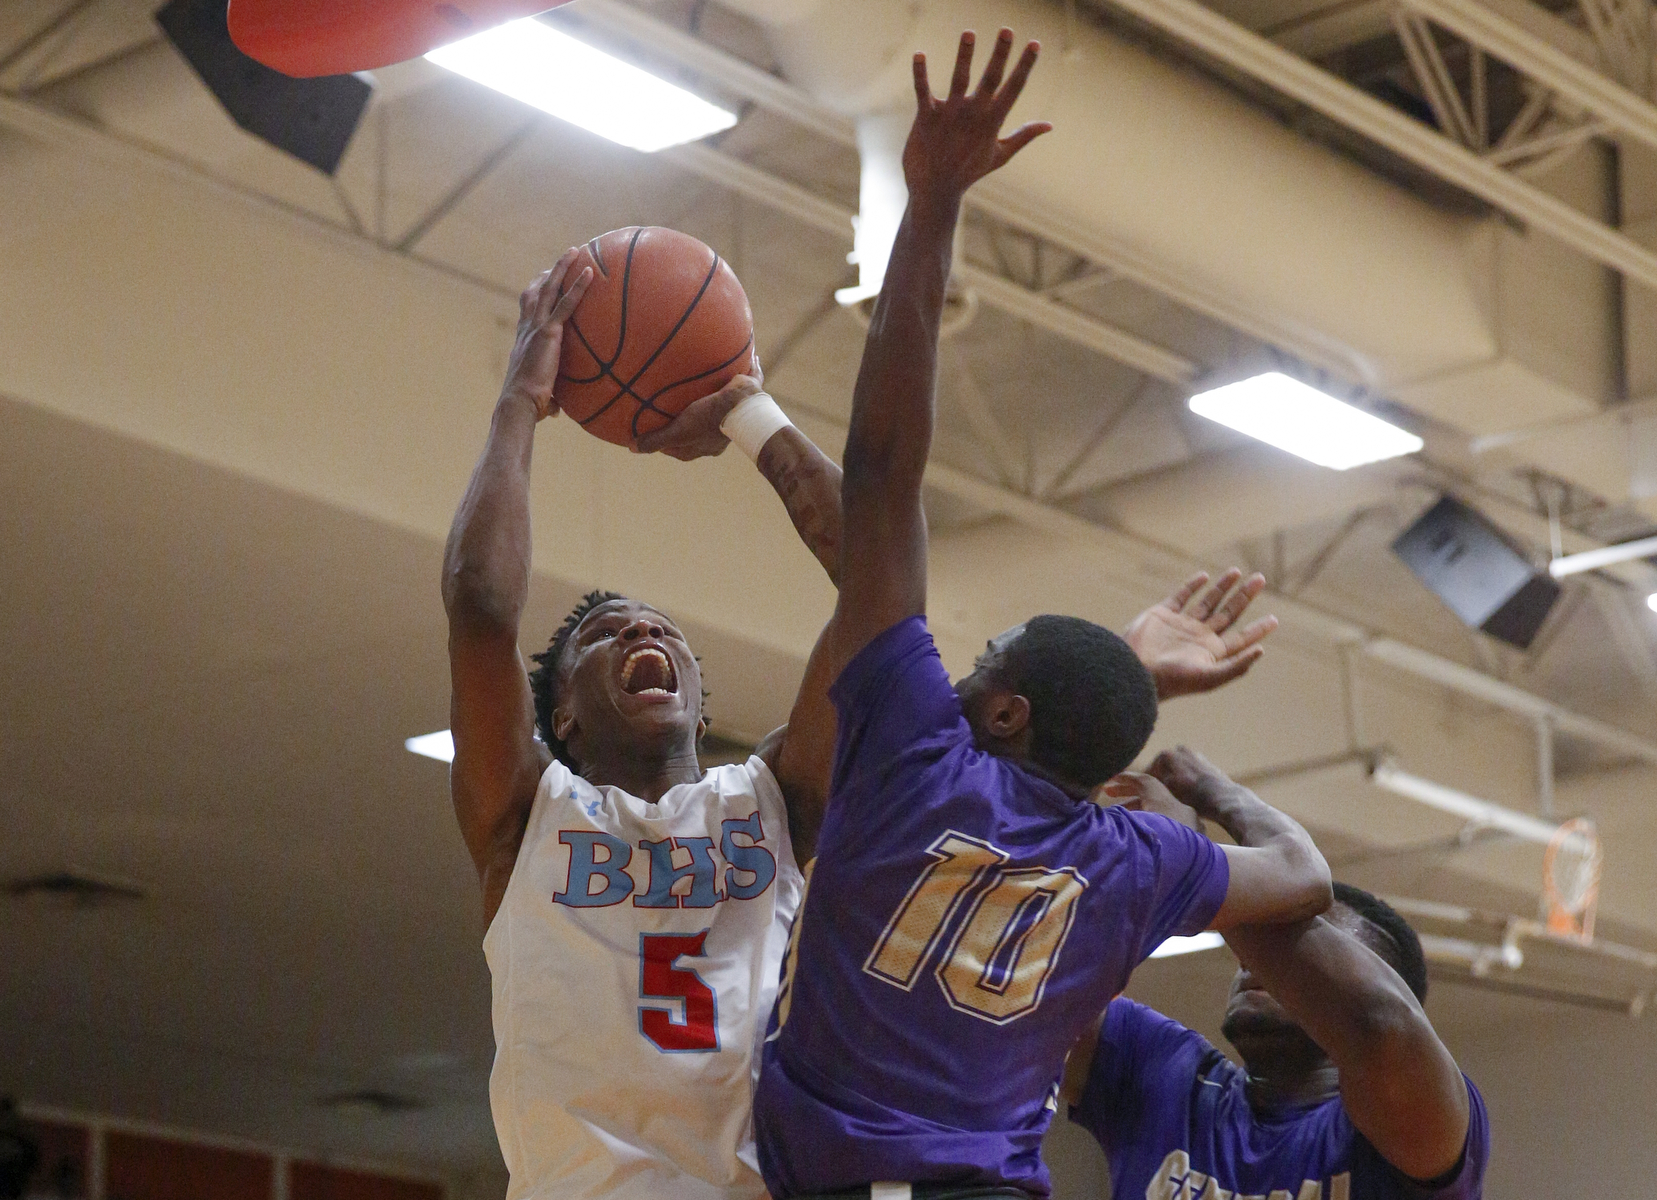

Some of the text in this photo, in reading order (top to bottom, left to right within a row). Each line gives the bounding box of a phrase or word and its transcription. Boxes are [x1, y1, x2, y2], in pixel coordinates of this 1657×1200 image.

[552, 811, 777, 909] BHS
[637, 927, 721, 1054] 5
[862, 829, 1090, 1026] 10
